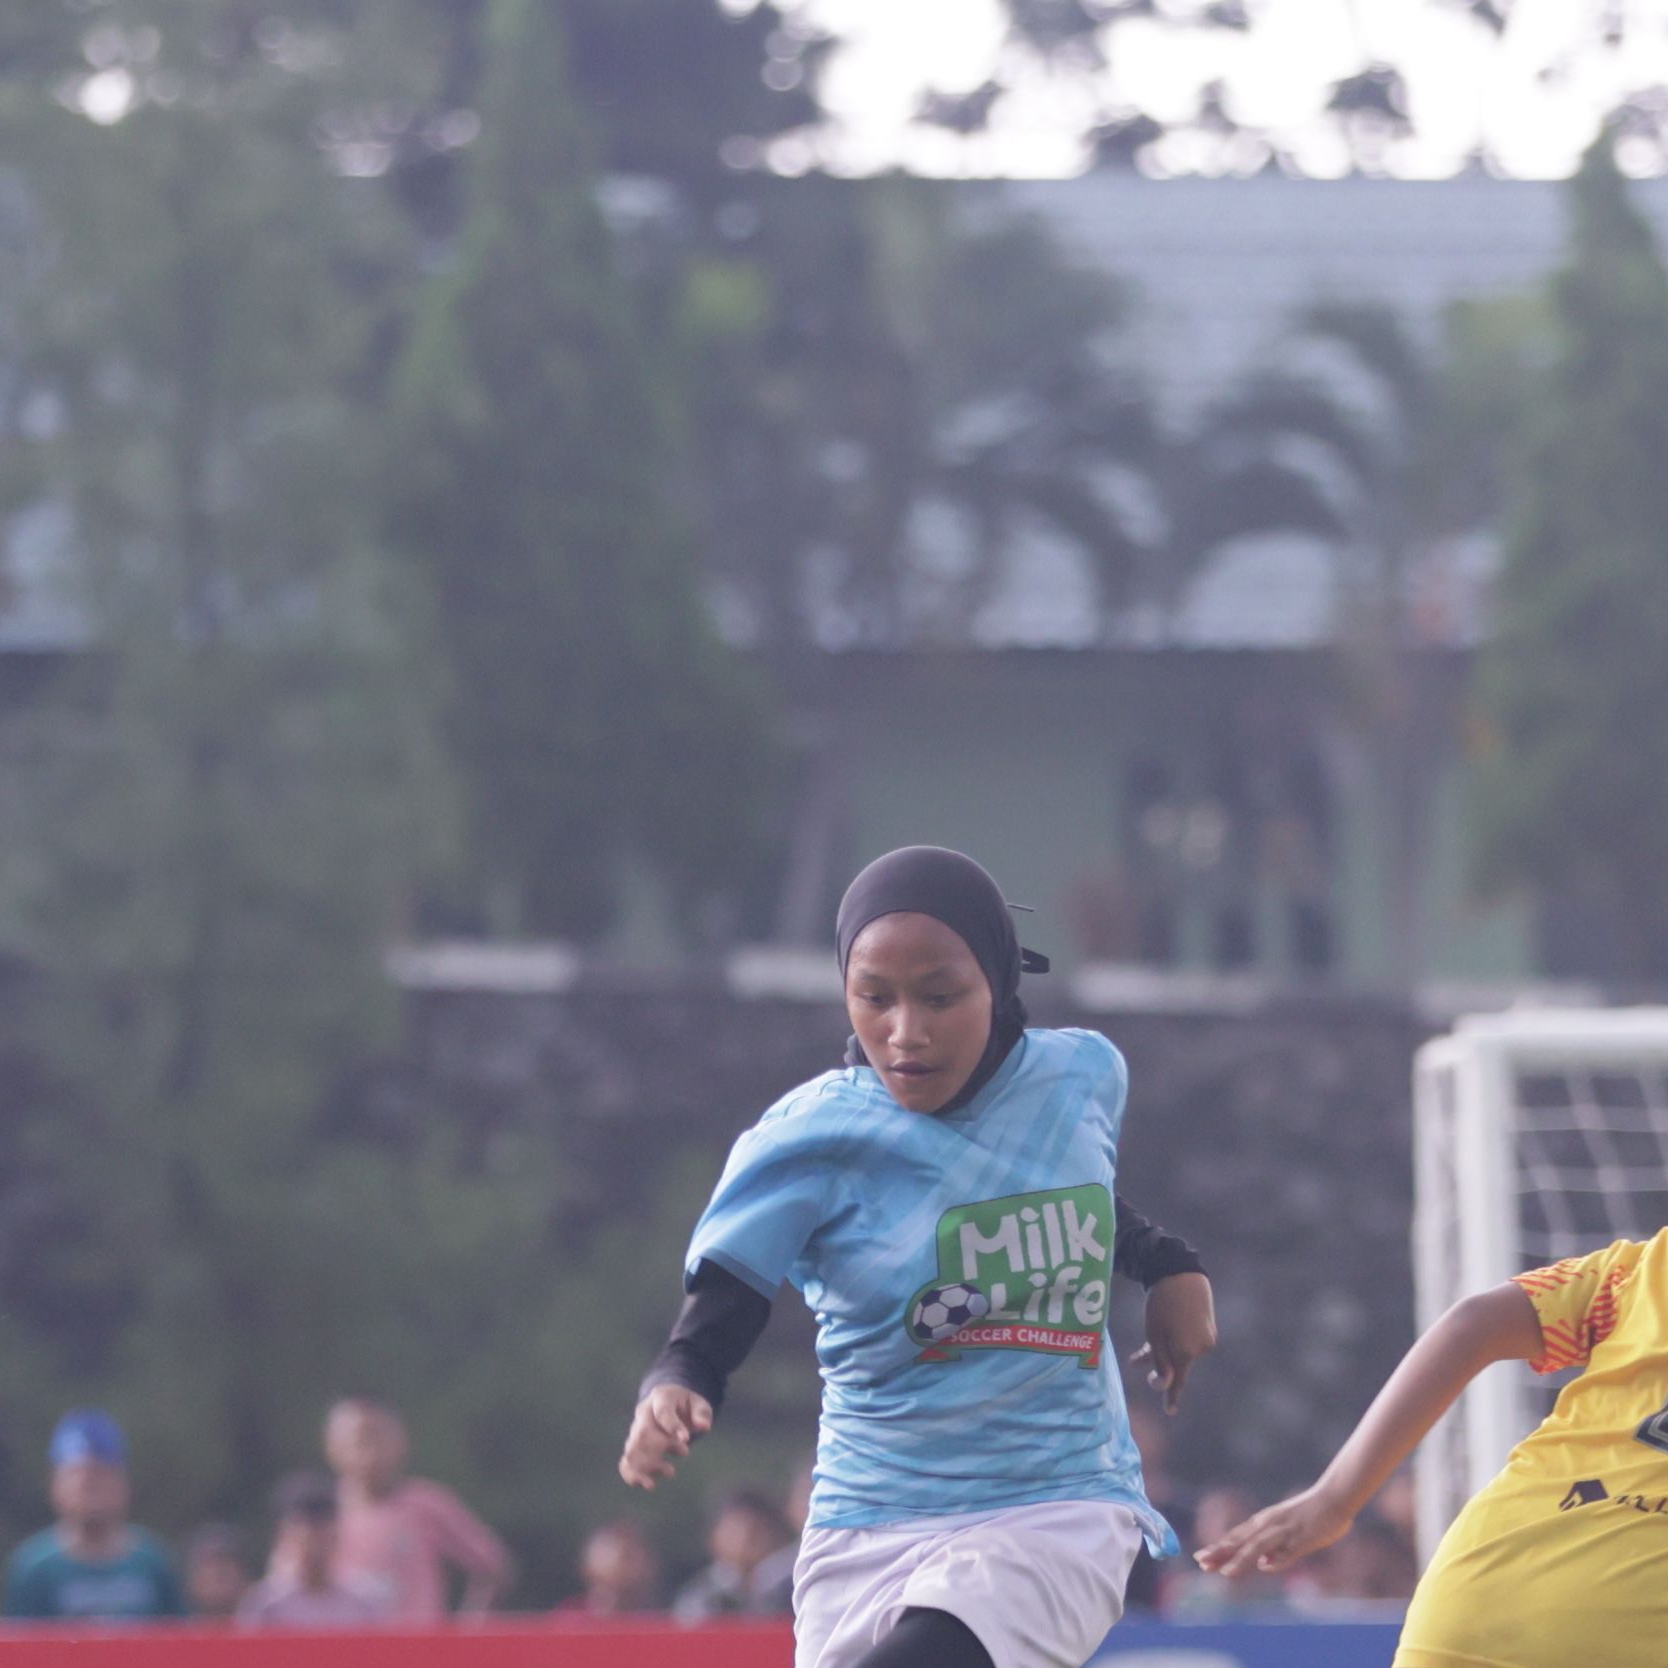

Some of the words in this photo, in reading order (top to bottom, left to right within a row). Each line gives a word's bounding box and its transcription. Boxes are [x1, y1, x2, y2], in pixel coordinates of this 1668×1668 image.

[959, 1200, 1106, 1281] Milk
[984, 1266, 1106, 1326] Life
[951, 1327, 1013, 1343] SOCCER
[1016, 1328, 1095, 1350] CHALLENGE
